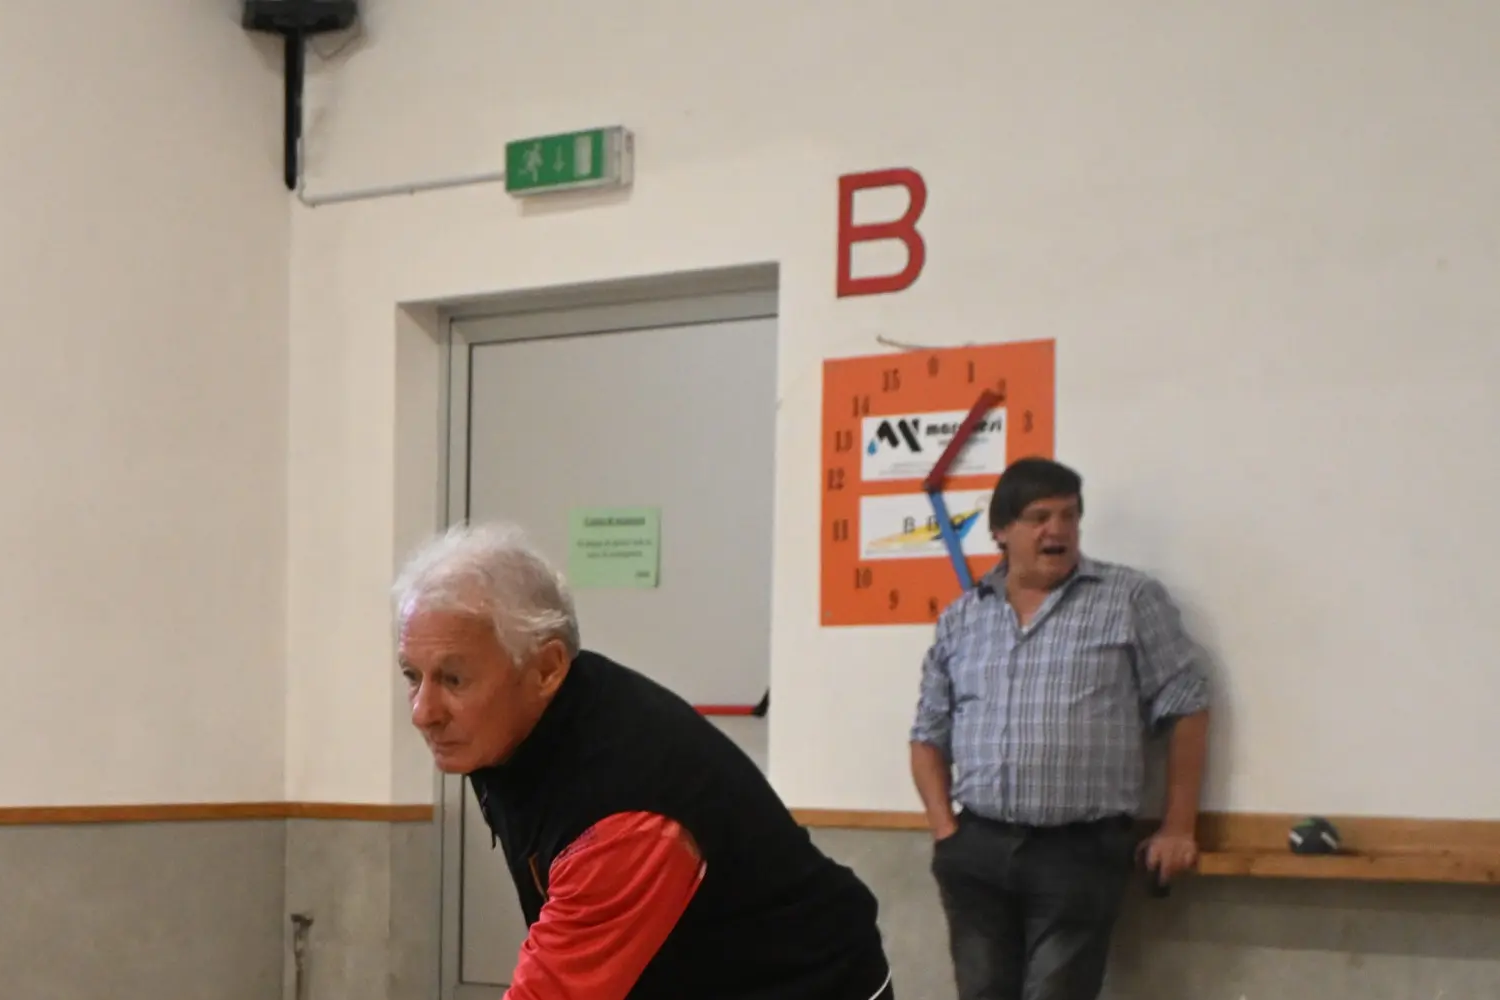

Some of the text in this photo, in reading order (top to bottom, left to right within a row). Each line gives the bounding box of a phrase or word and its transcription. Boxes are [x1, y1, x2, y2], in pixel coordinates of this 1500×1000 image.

[836, 167, 928, 298] B
[882, 368, 901, 393] 15
[827, 467, 846, 491] 12
[832, 518, 849, 542] 11
[855, 566, 874, 590] 10
